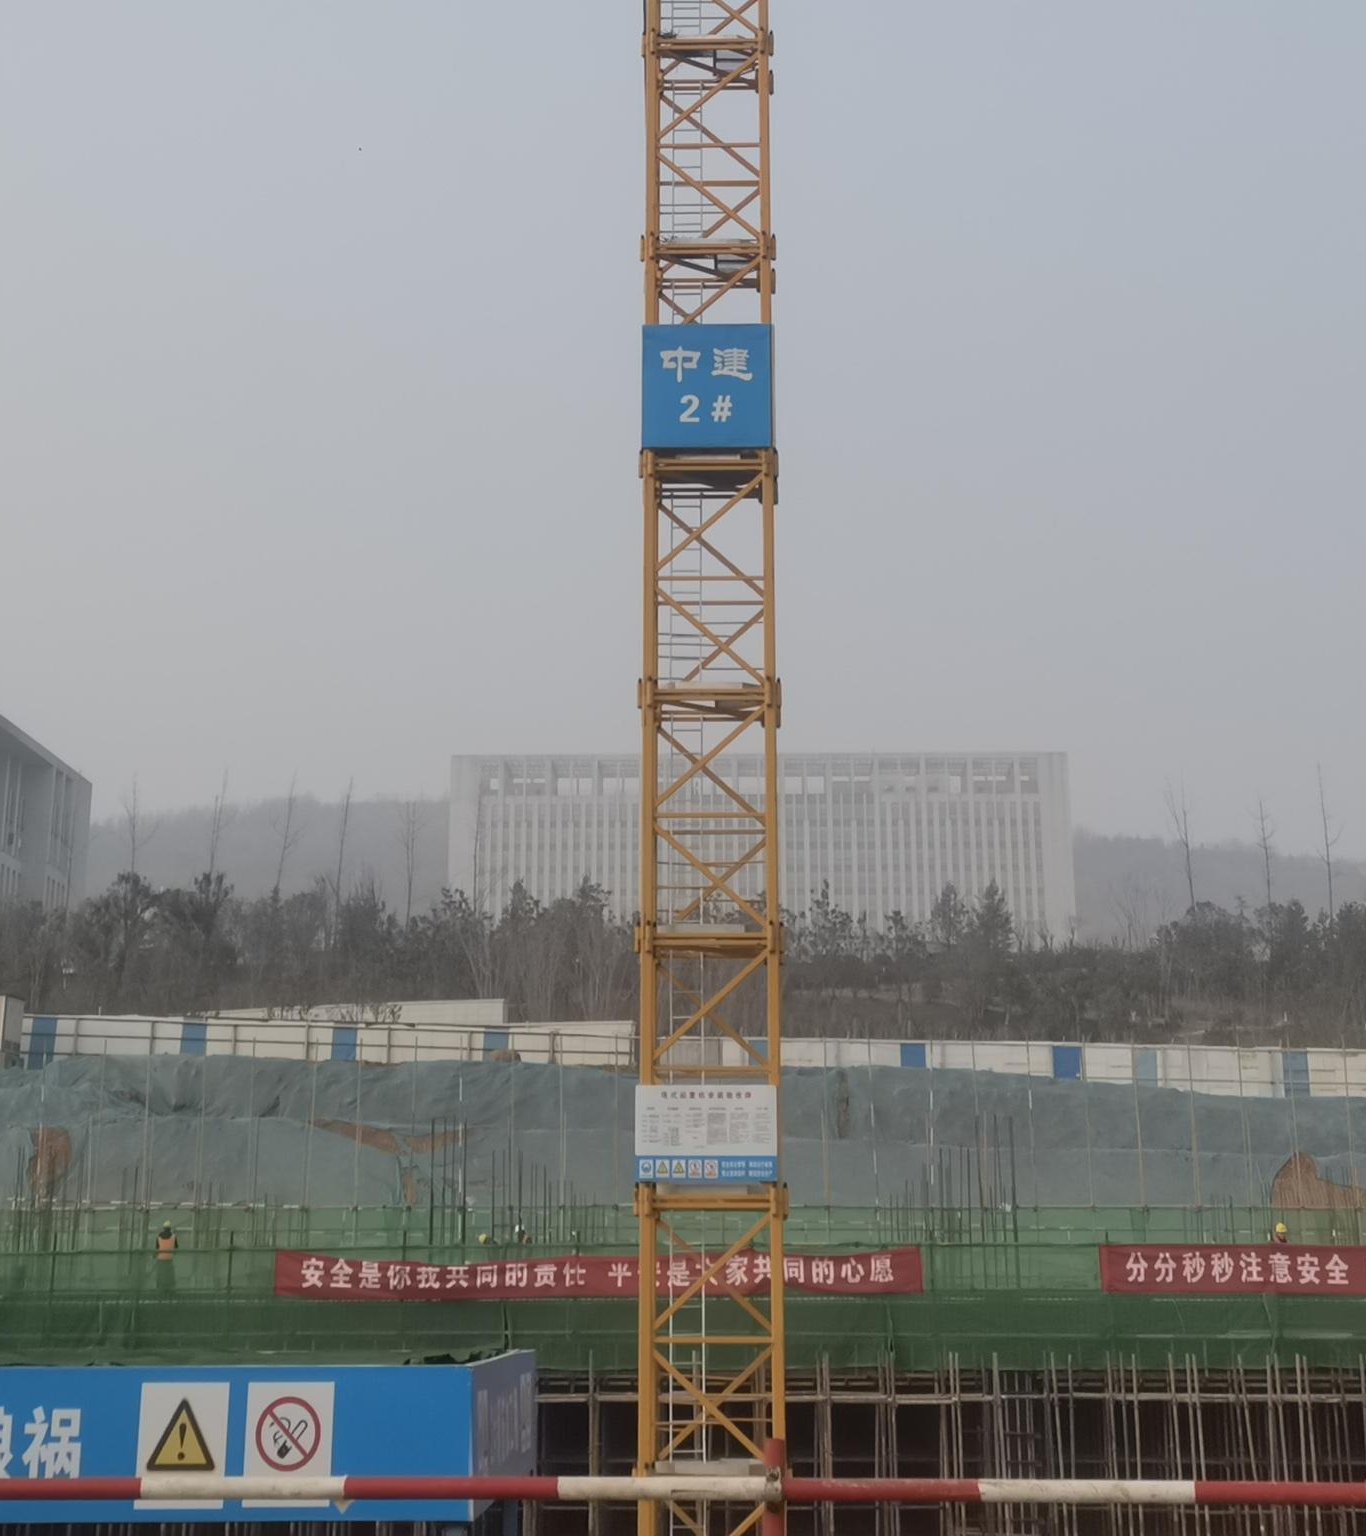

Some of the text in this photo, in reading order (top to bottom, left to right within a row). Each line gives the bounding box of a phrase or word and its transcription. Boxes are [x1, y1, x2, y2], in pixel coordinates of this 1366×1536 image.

[659, 346, 754, 383] 中建
[679, 394, 733, 423] 2#
[1125, 1251, 1350, 1286] 分分秒秒注意安全
